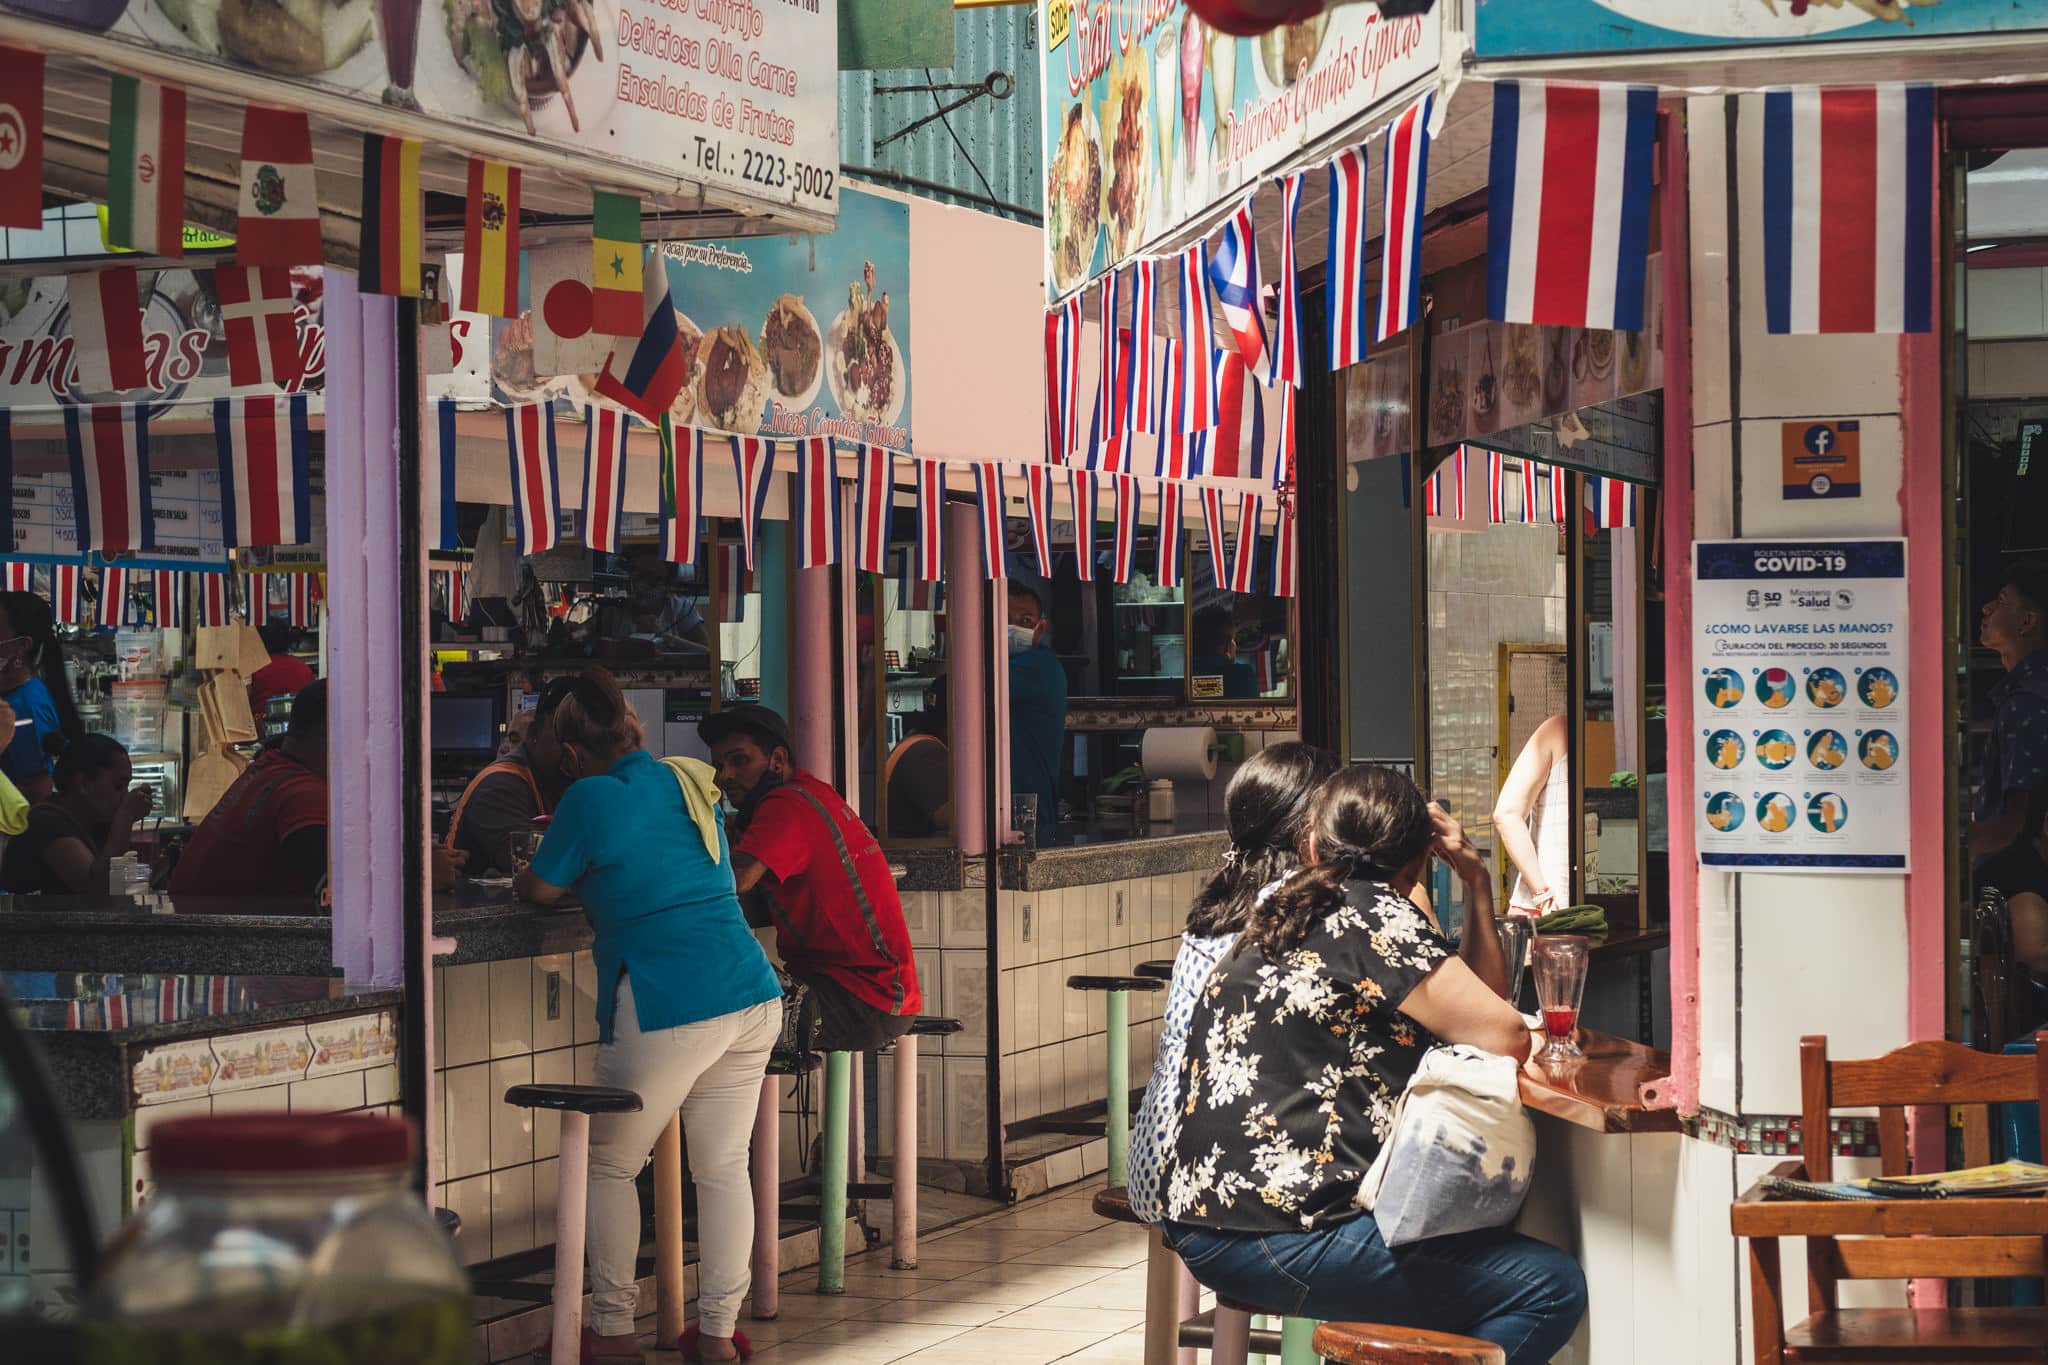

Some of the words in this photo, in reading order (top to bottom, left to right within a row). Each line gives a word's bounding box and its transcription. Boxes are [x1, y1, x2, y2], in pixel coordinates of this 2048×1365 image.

[618, 9, 700, 69] Deliciosa
[705, 38, 742, 81] Olla
[747, 51, 798, 97] Carne
[1293, 35, 1358, 123] Comidas
[617, 63, 708, 123] Ensaladas
[711, 92, 736, 129] de
[739, 98, 795, 146] Frutas
[742, 149, 834, 200] 2223-5002
[684, 246, 700, 265] por
[699, 248, 709, 262] su
[1754, 556, 1847, 573] COVID-19
[1798, 597, 1831, 608] Salud
[1754, 623, 1809, 635] LAVARSE
[1812, 623, 1834, 634] LAS
[1838, 622, 1893, 634] MANOS?
[1768, 640, 1784, 650] DEL
[1786, 640, 1827, 650] PROCESO:
[1841, 640, 1887, 650] SEGUNDOS
